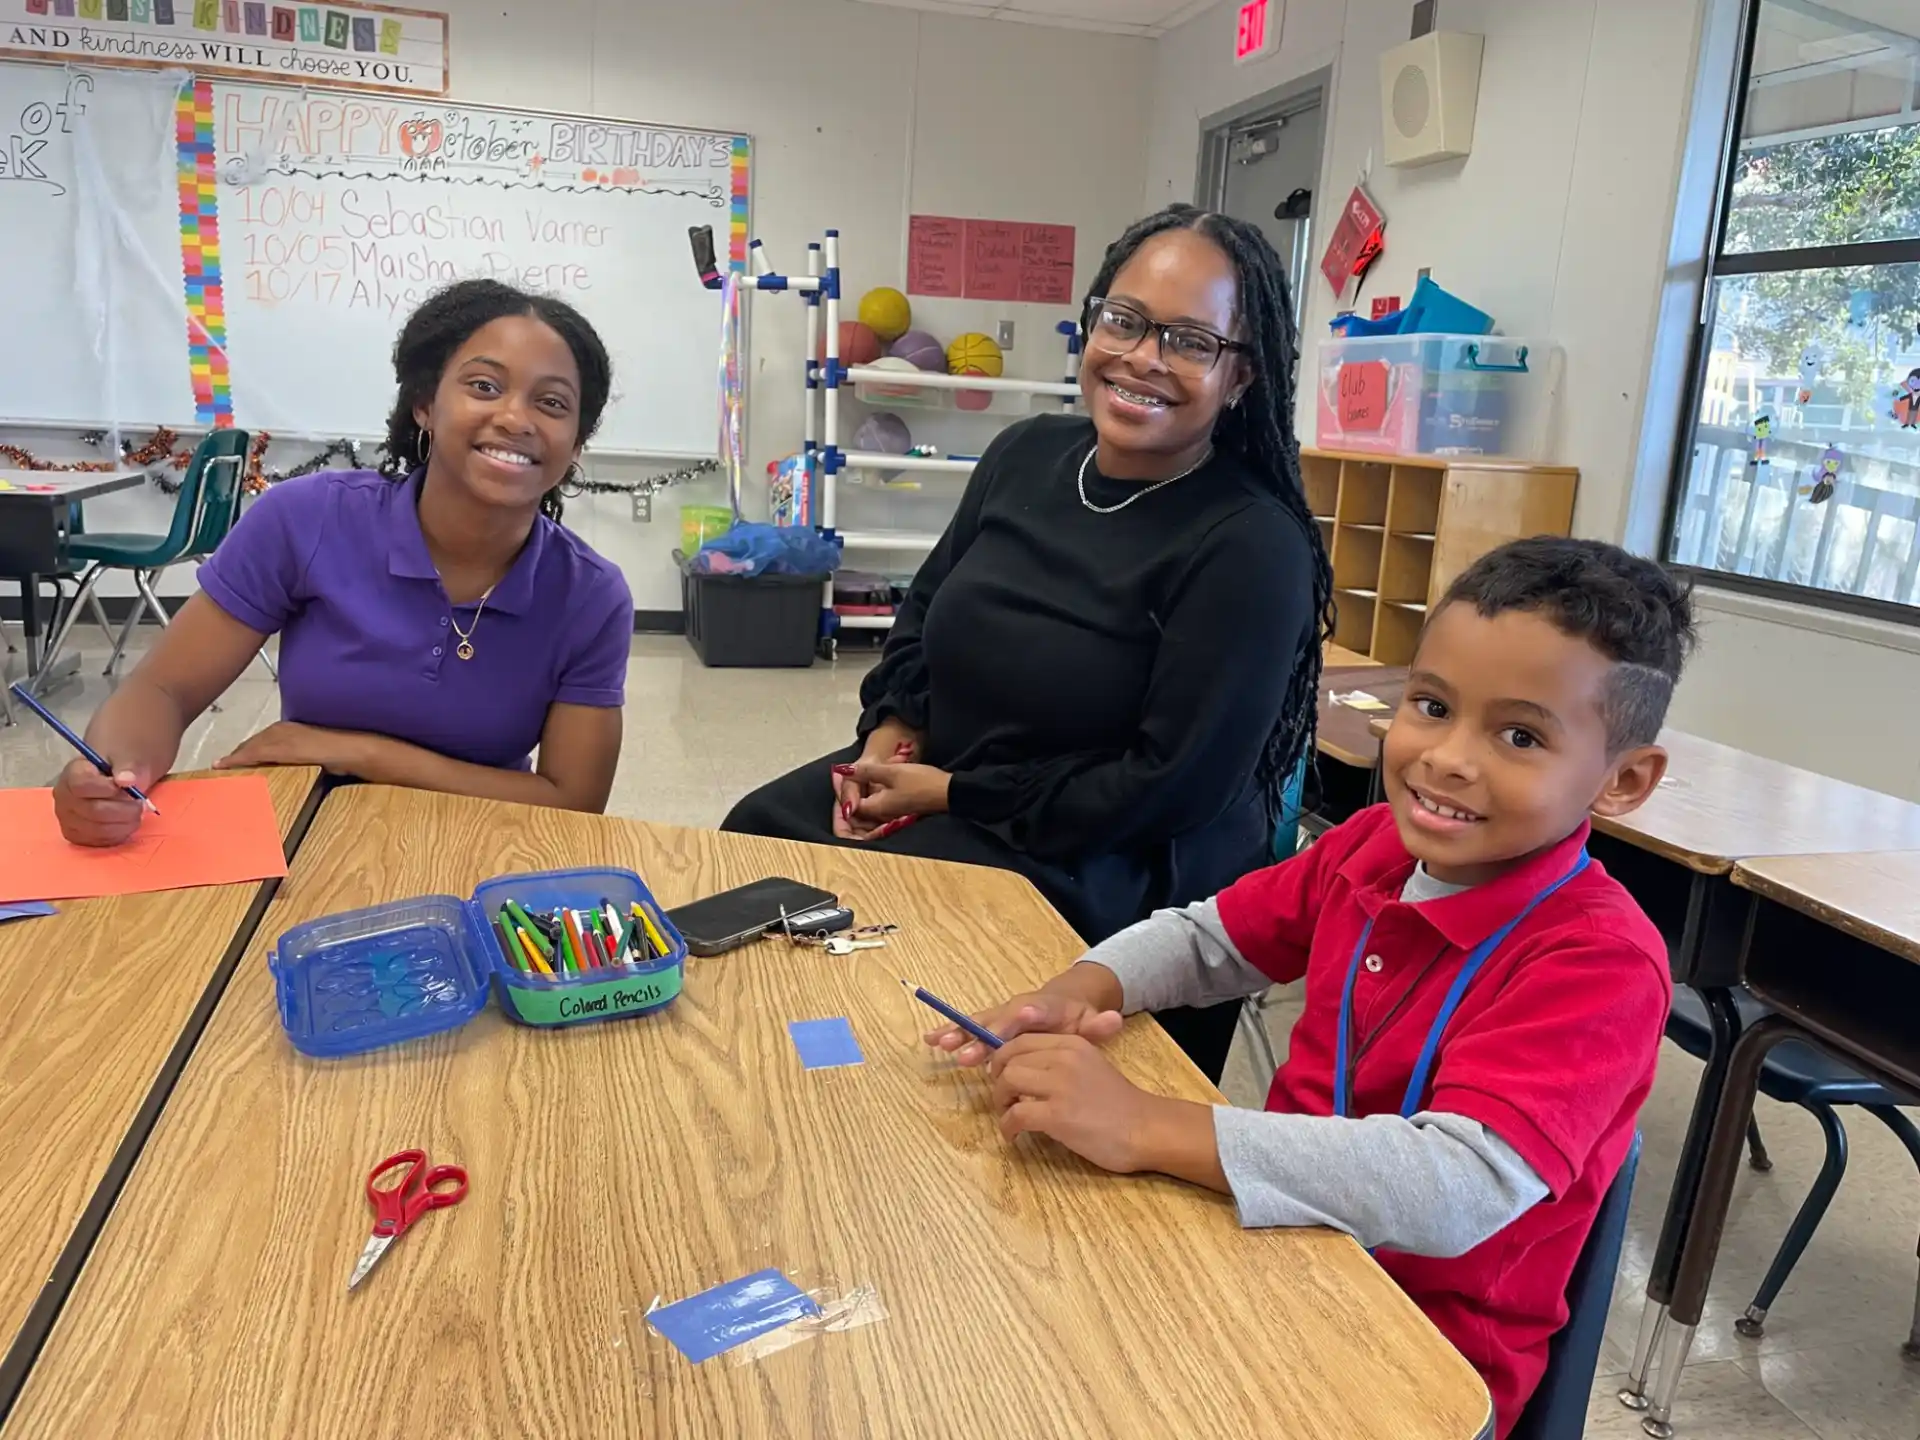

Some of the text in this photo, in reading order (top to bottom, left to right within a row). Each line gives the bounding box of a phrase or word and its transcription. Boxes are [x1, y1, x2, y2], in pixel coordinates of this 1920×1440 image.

[199, 1, 399, 48] KINDNESS
[9, 26, 414, 84] AND kindness WILL choose YOU.
[224, 93, 399, 155] HAPPY
[235, 185, 326, 228] 10/04
[341, 188, 505, 242] Sebastian
[244, 230, 348, 271] 10/05
[245, 266, 342, 304] 10/17
[559, 984, 662, 1018] Colored Pencils
